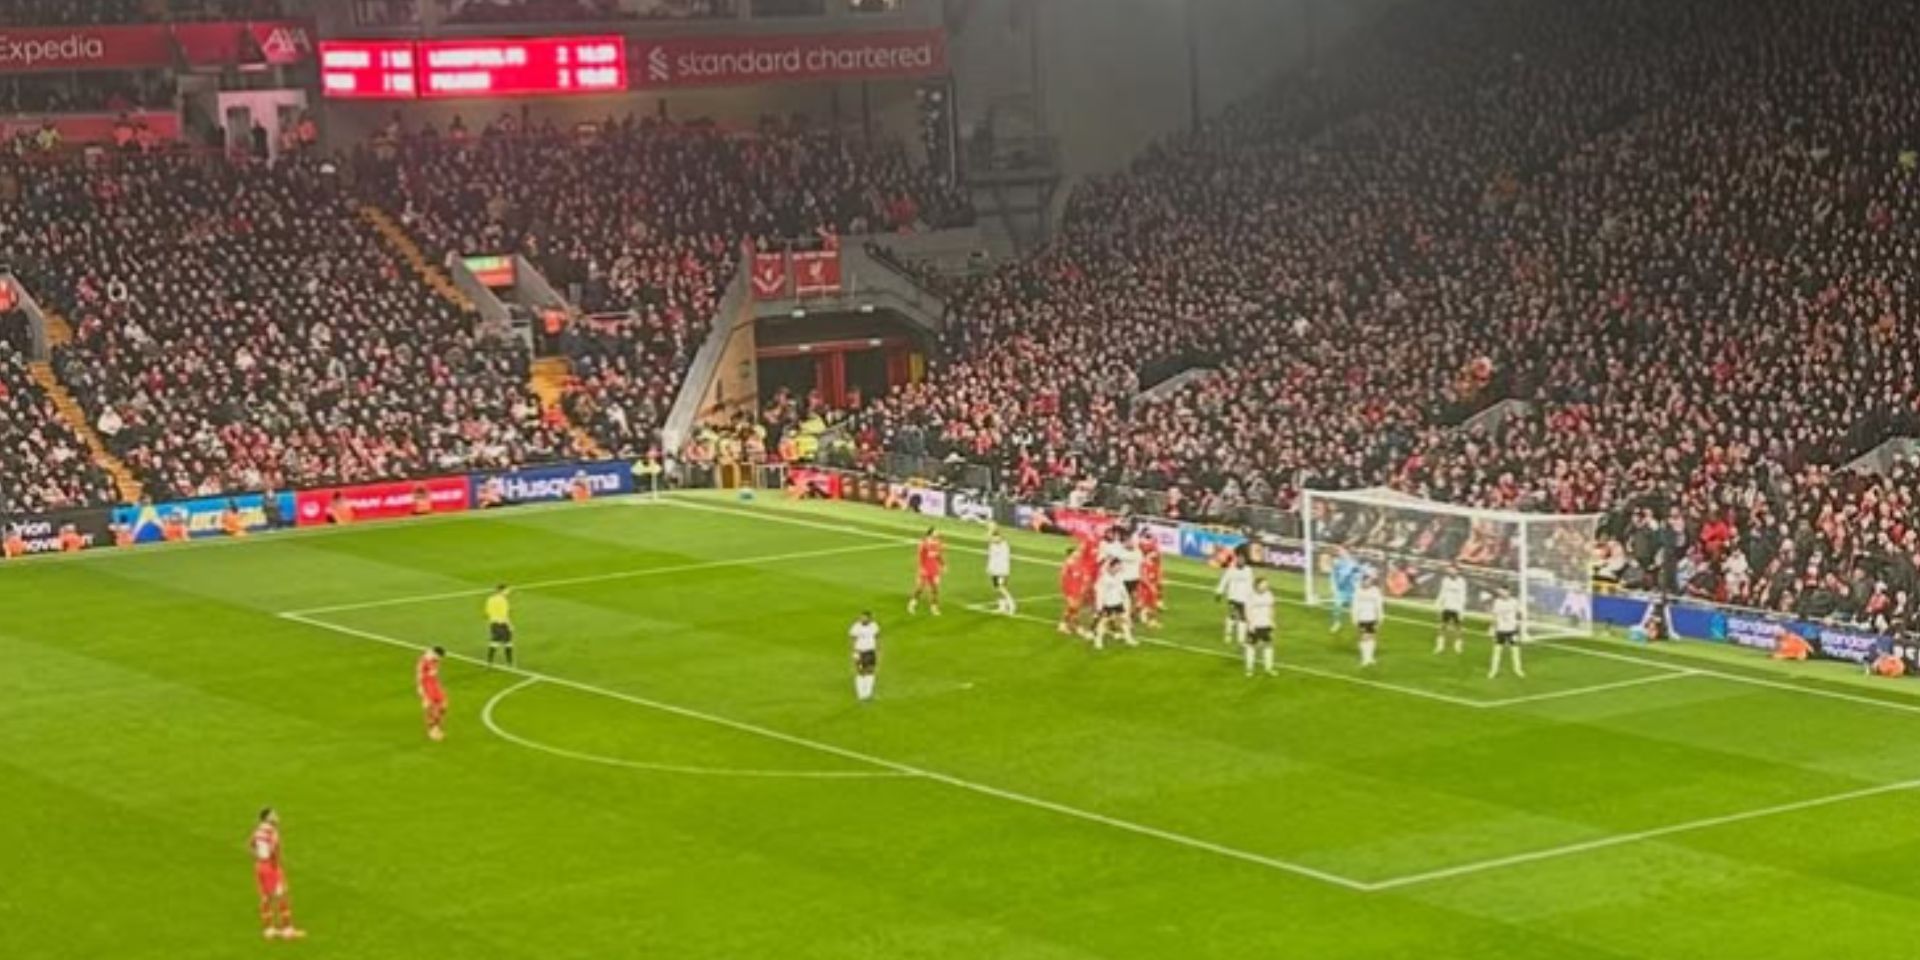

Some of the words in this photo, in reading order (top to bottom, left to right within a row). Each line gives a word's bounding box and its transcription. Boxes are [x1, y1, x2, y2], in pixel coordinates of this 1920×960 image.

[0, 34, 103, 64] Expedia
[262, 28, 311, 52] AXA
[677, 49, 799, 75] standard
[806, 45, 931, 70] chartered
[507, 472, 620, 498] Husqvrna
